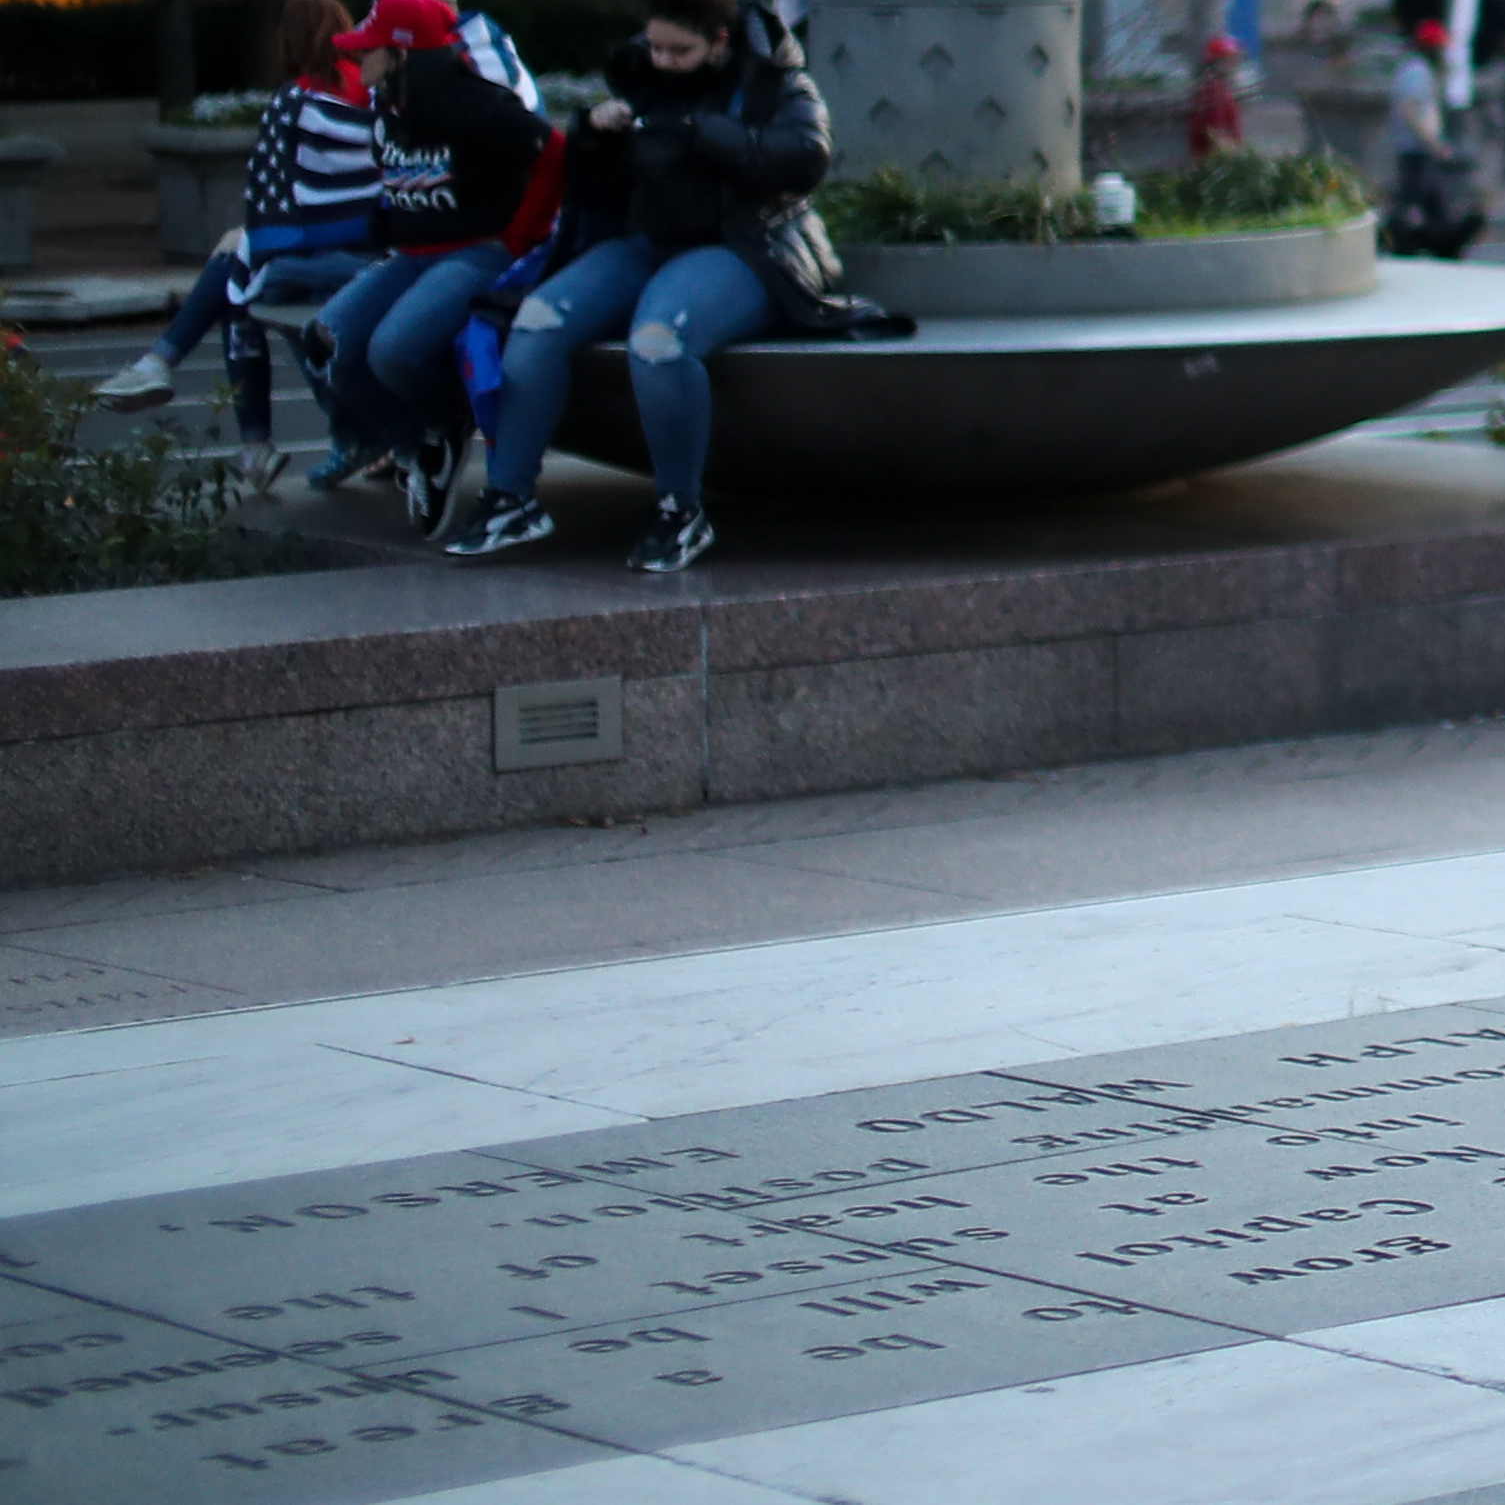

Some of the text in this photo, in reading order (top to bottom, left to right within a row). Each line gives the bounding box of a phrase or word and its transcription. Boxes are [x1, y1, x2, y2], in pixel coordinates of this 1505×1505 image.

[855, 1078, 1195, 1134] WALDO
[1265, 1112, 1466, 1147] into
[1032, 1156, 1204, 1186] the
[682, 1195, 973, 1247] heart
[1098, 1192, 1210, 1216] at
[1075, 1198, 1436, 1266] Capitol
[496, 1253, 599, 1281] of
[648, 1226, 1010, 1295] sunset
[1227, 1235, 1453, 1285] grow
[221, 1286, 417, 1320] the
[797, 1278, 991, 1317] will
[1021, 1299, 1141, 1322] to
[568, 1326, 713, 1354] be
[801, 1333, 947, 1361] be
[1, 1331, 403, 1408] seemed
[654, 1369, 725, 1387] a
[200, 1393, 572, 1471] great
